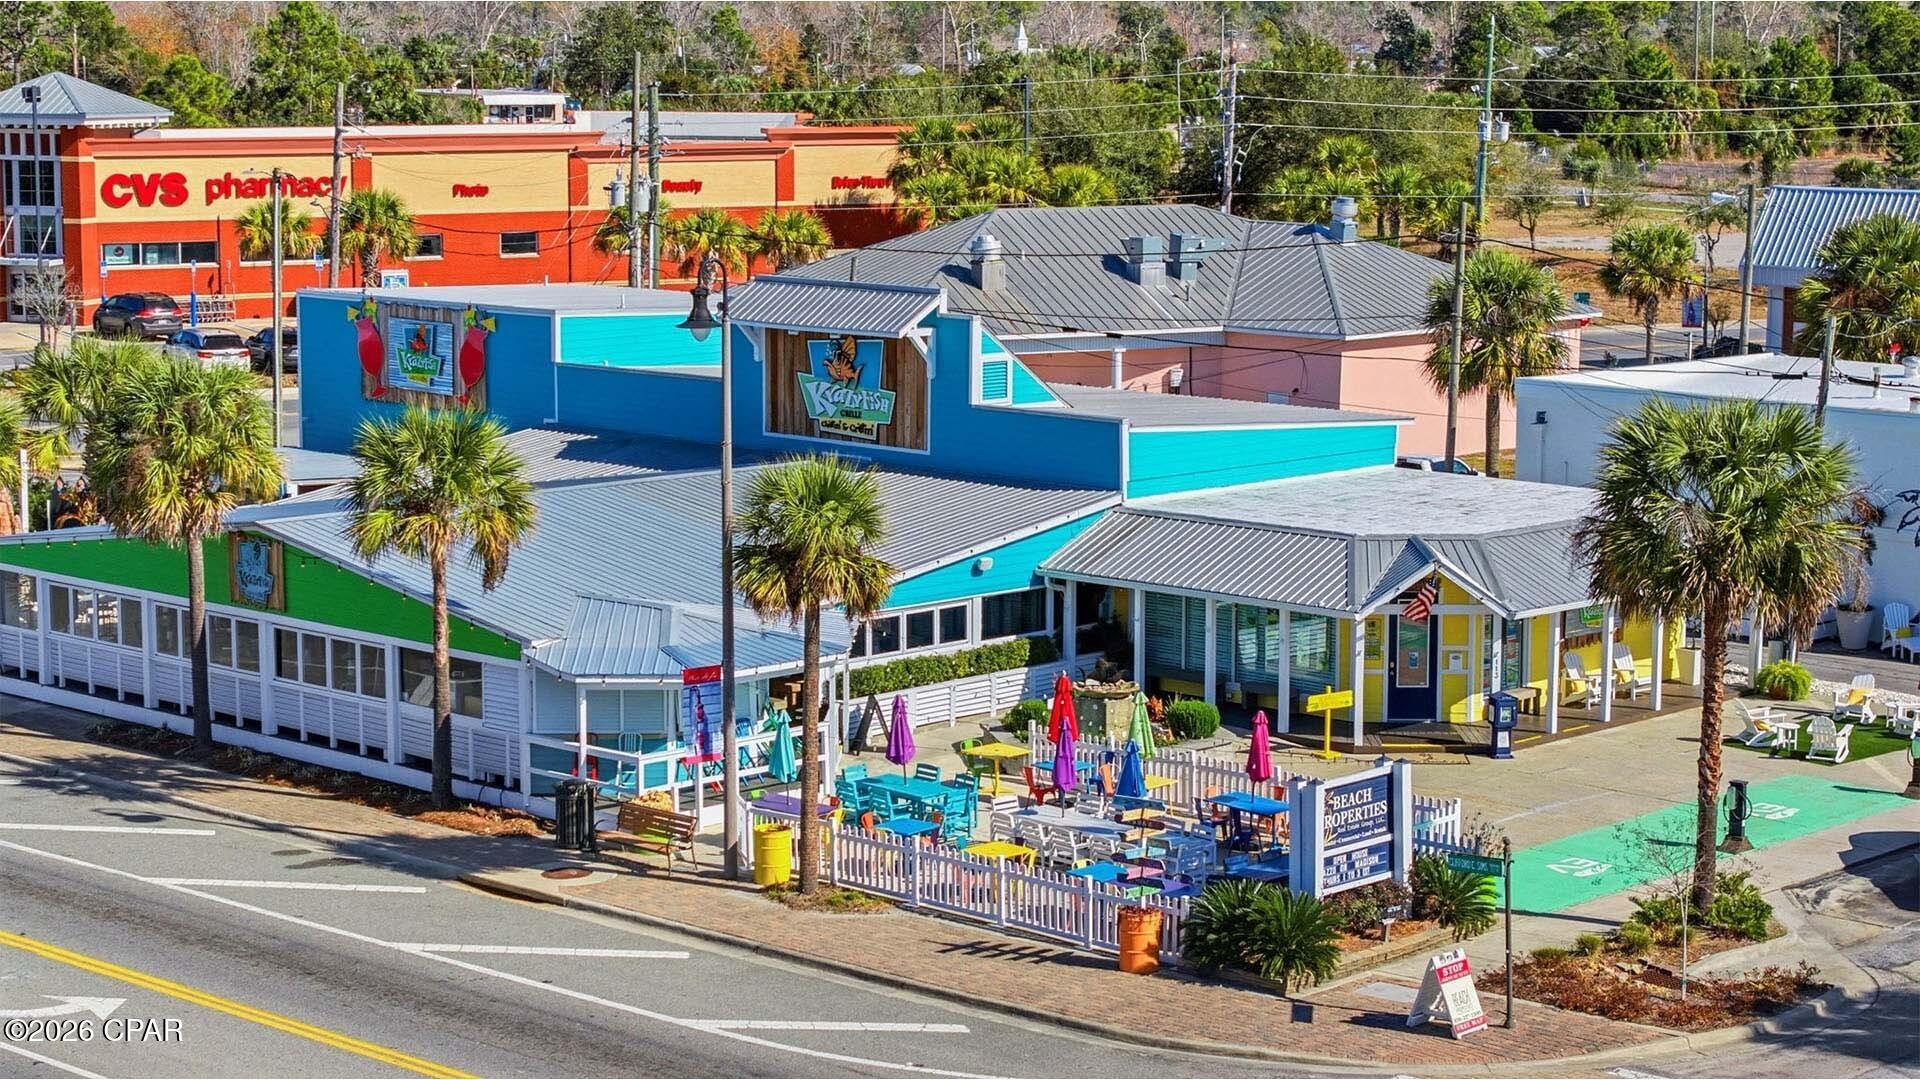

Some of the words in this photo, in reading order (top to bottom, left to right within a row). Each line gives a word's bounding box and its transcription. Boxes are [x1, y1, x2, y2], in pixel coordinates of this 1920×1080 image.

[100, 172, 189, 208] CVS
[1333, 787, 1373, 810] BEACH
[1324, 800, 1388, 829] ROPERTIES
[1442, 962, 1464, 977] STOP
